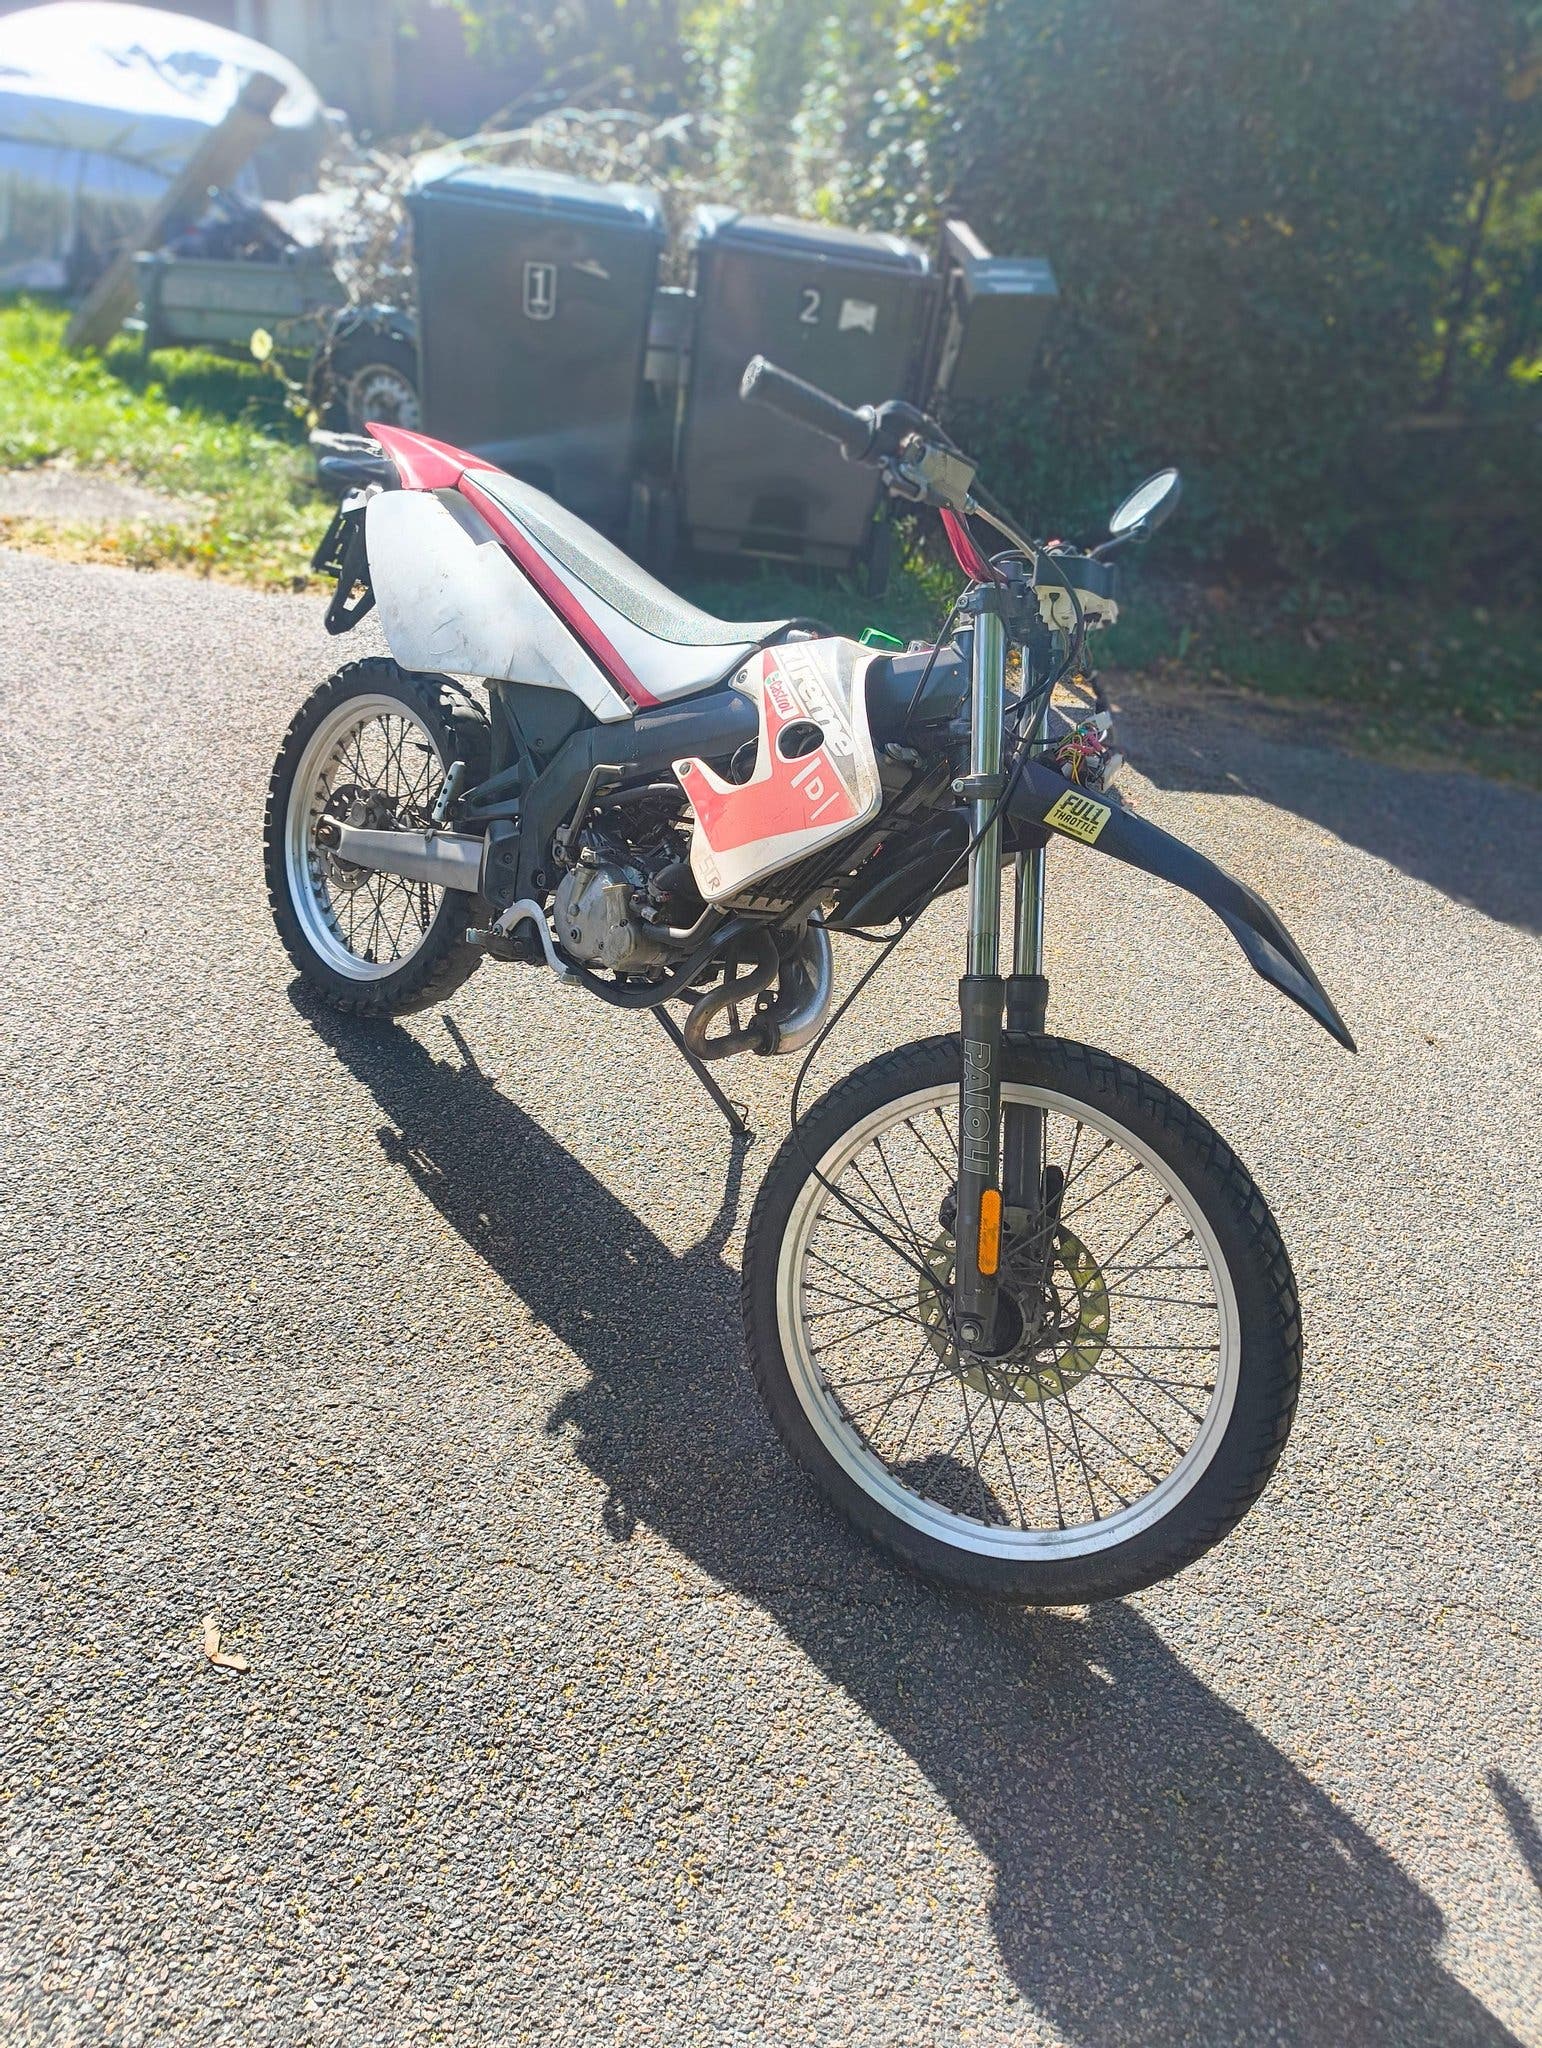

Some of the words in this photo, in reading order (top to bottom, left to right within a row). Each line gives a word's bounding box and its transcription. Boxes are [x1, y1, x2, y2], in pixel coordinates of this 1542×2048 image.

[530, 270, 549, 306] 1
[799, 289, 821, 325] 2
[769, 680, 794, 714] Castrol
[1053, 809, 1098, 835] THROTTLE
[1060, 794, 1104, 826] FULL
[963, 1038, 991, 1176] PAIOLI
